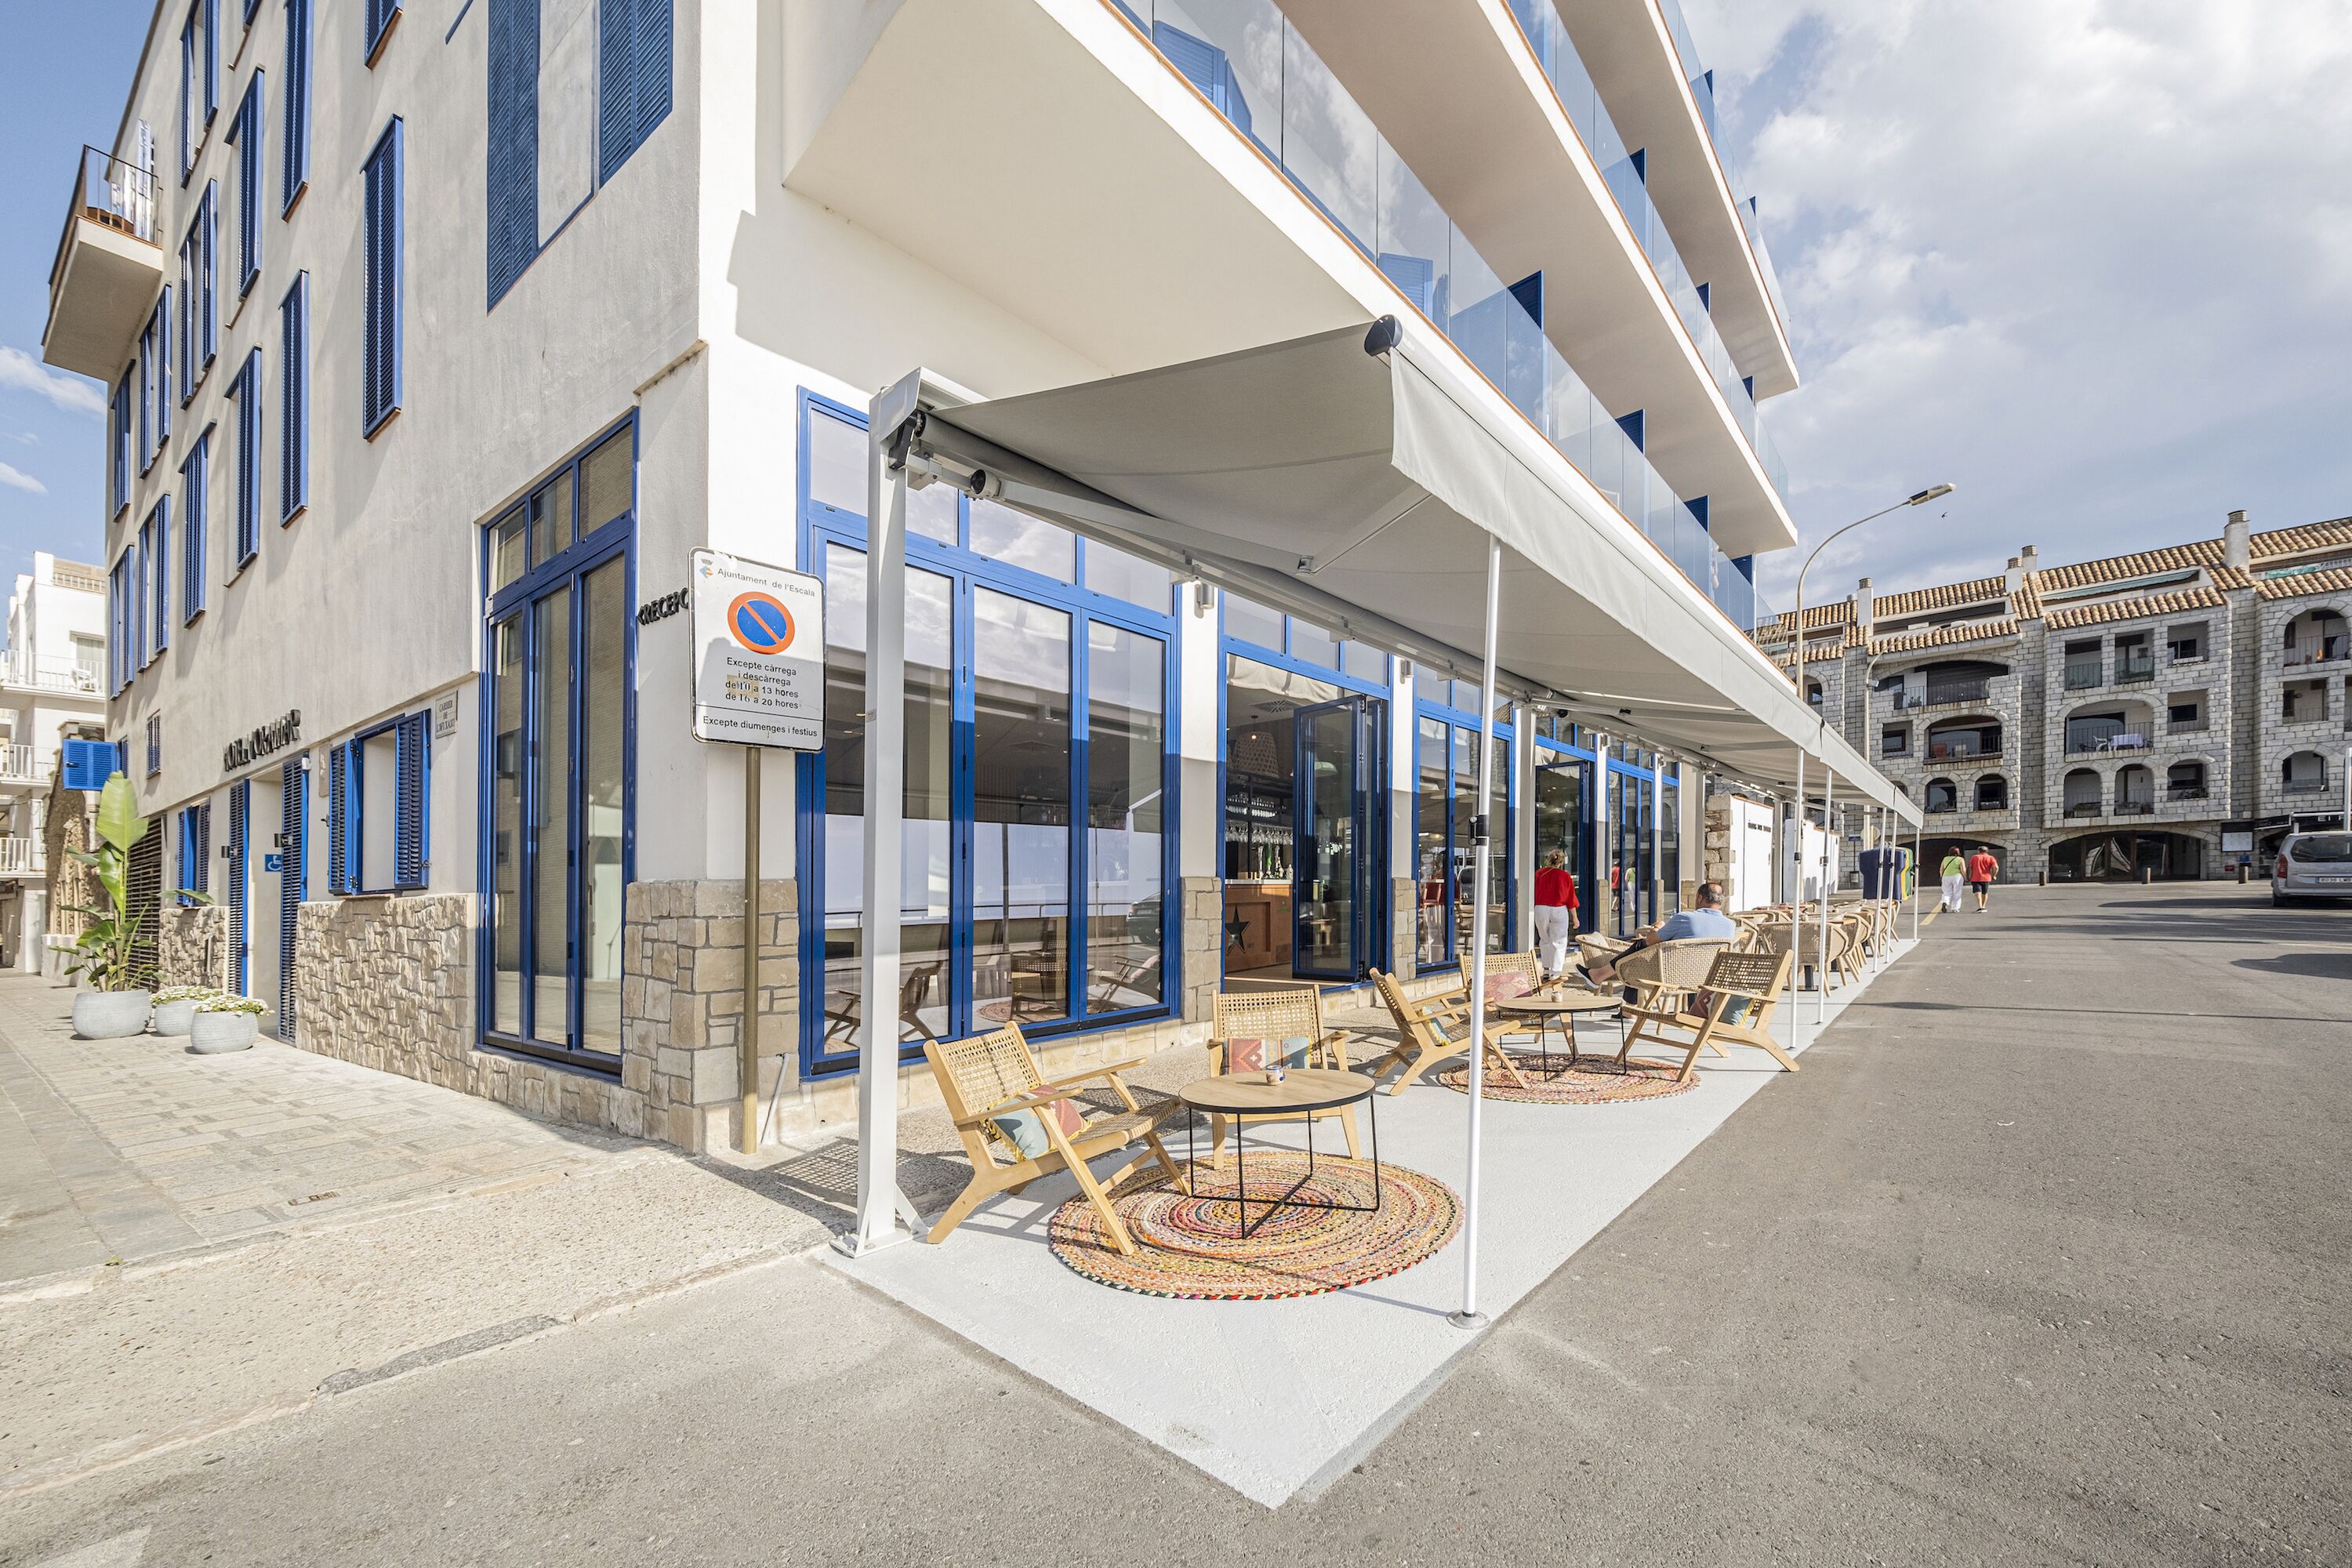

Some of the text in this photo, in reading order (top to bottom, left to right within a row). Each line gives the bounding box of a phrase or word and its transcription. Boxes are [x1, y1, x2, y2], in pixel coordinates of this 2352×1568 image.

[717, 568, 767, 586] Ajuntament
[785, 584, 815, 597] l'Escala
[727, 657, 797, 677] Excepte càrrega
[742, 672, 791, 687] descàrrega
[725, 681, 736, 689] de
[762, 686, 772, 695] 13
[775, 688, 799, 699] hores
[725, 692, 736, 701] de
[761, 698, 772, 706] 20
[775, 699, 799, 709] hores
[703, 716, 738, 728] Excepte
[741, 721, 786, 733] diumenges
[792, 727, 818, 737] festius
